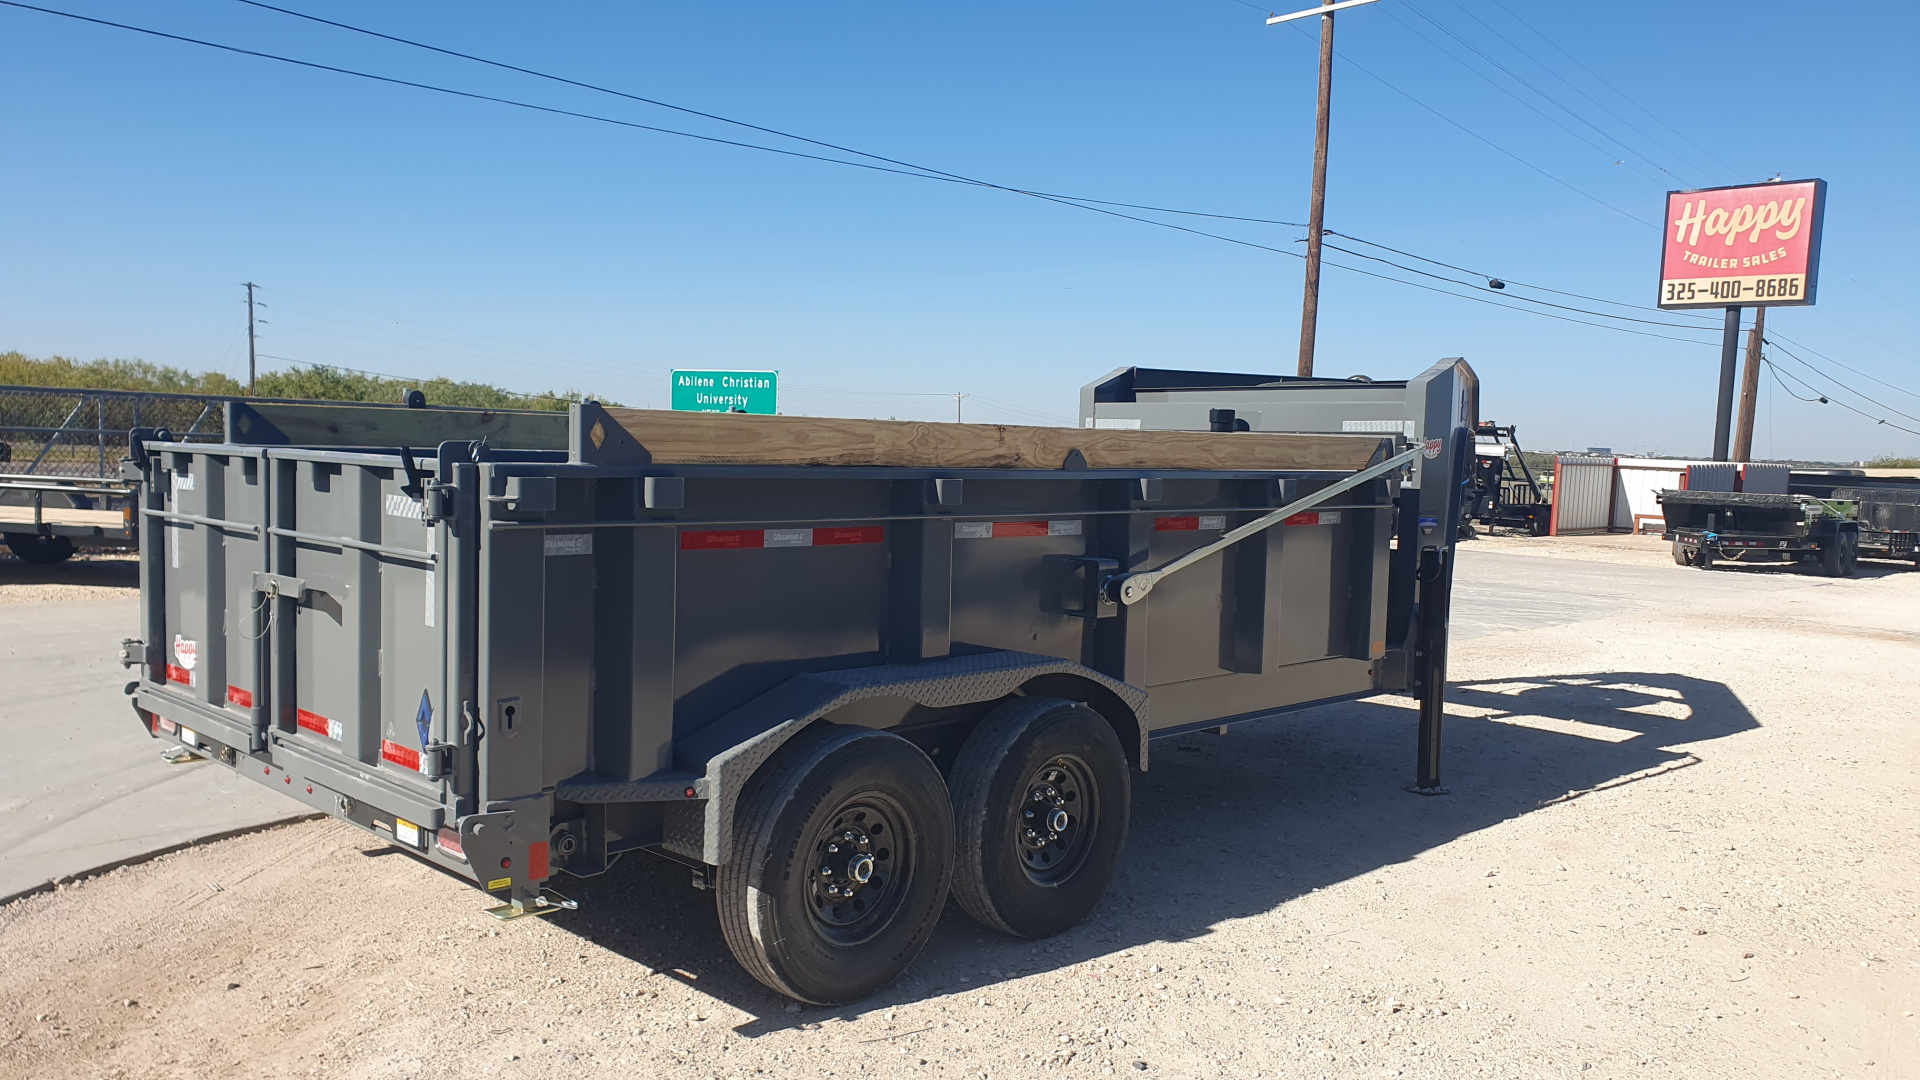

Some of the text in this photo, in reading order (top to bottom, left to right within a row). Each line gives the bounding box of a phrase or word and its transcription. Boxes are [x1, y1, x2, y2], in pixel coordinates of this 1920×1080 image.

[1674, 197, 1806, 246] Happy
[1682, 246, 1787, 269] TRAILER SALES
[1666, 278, 1799, 301] 325-400-8686
[678, 375, 770, 389] Abilene Christian
[696, 392, 748, 408] University
